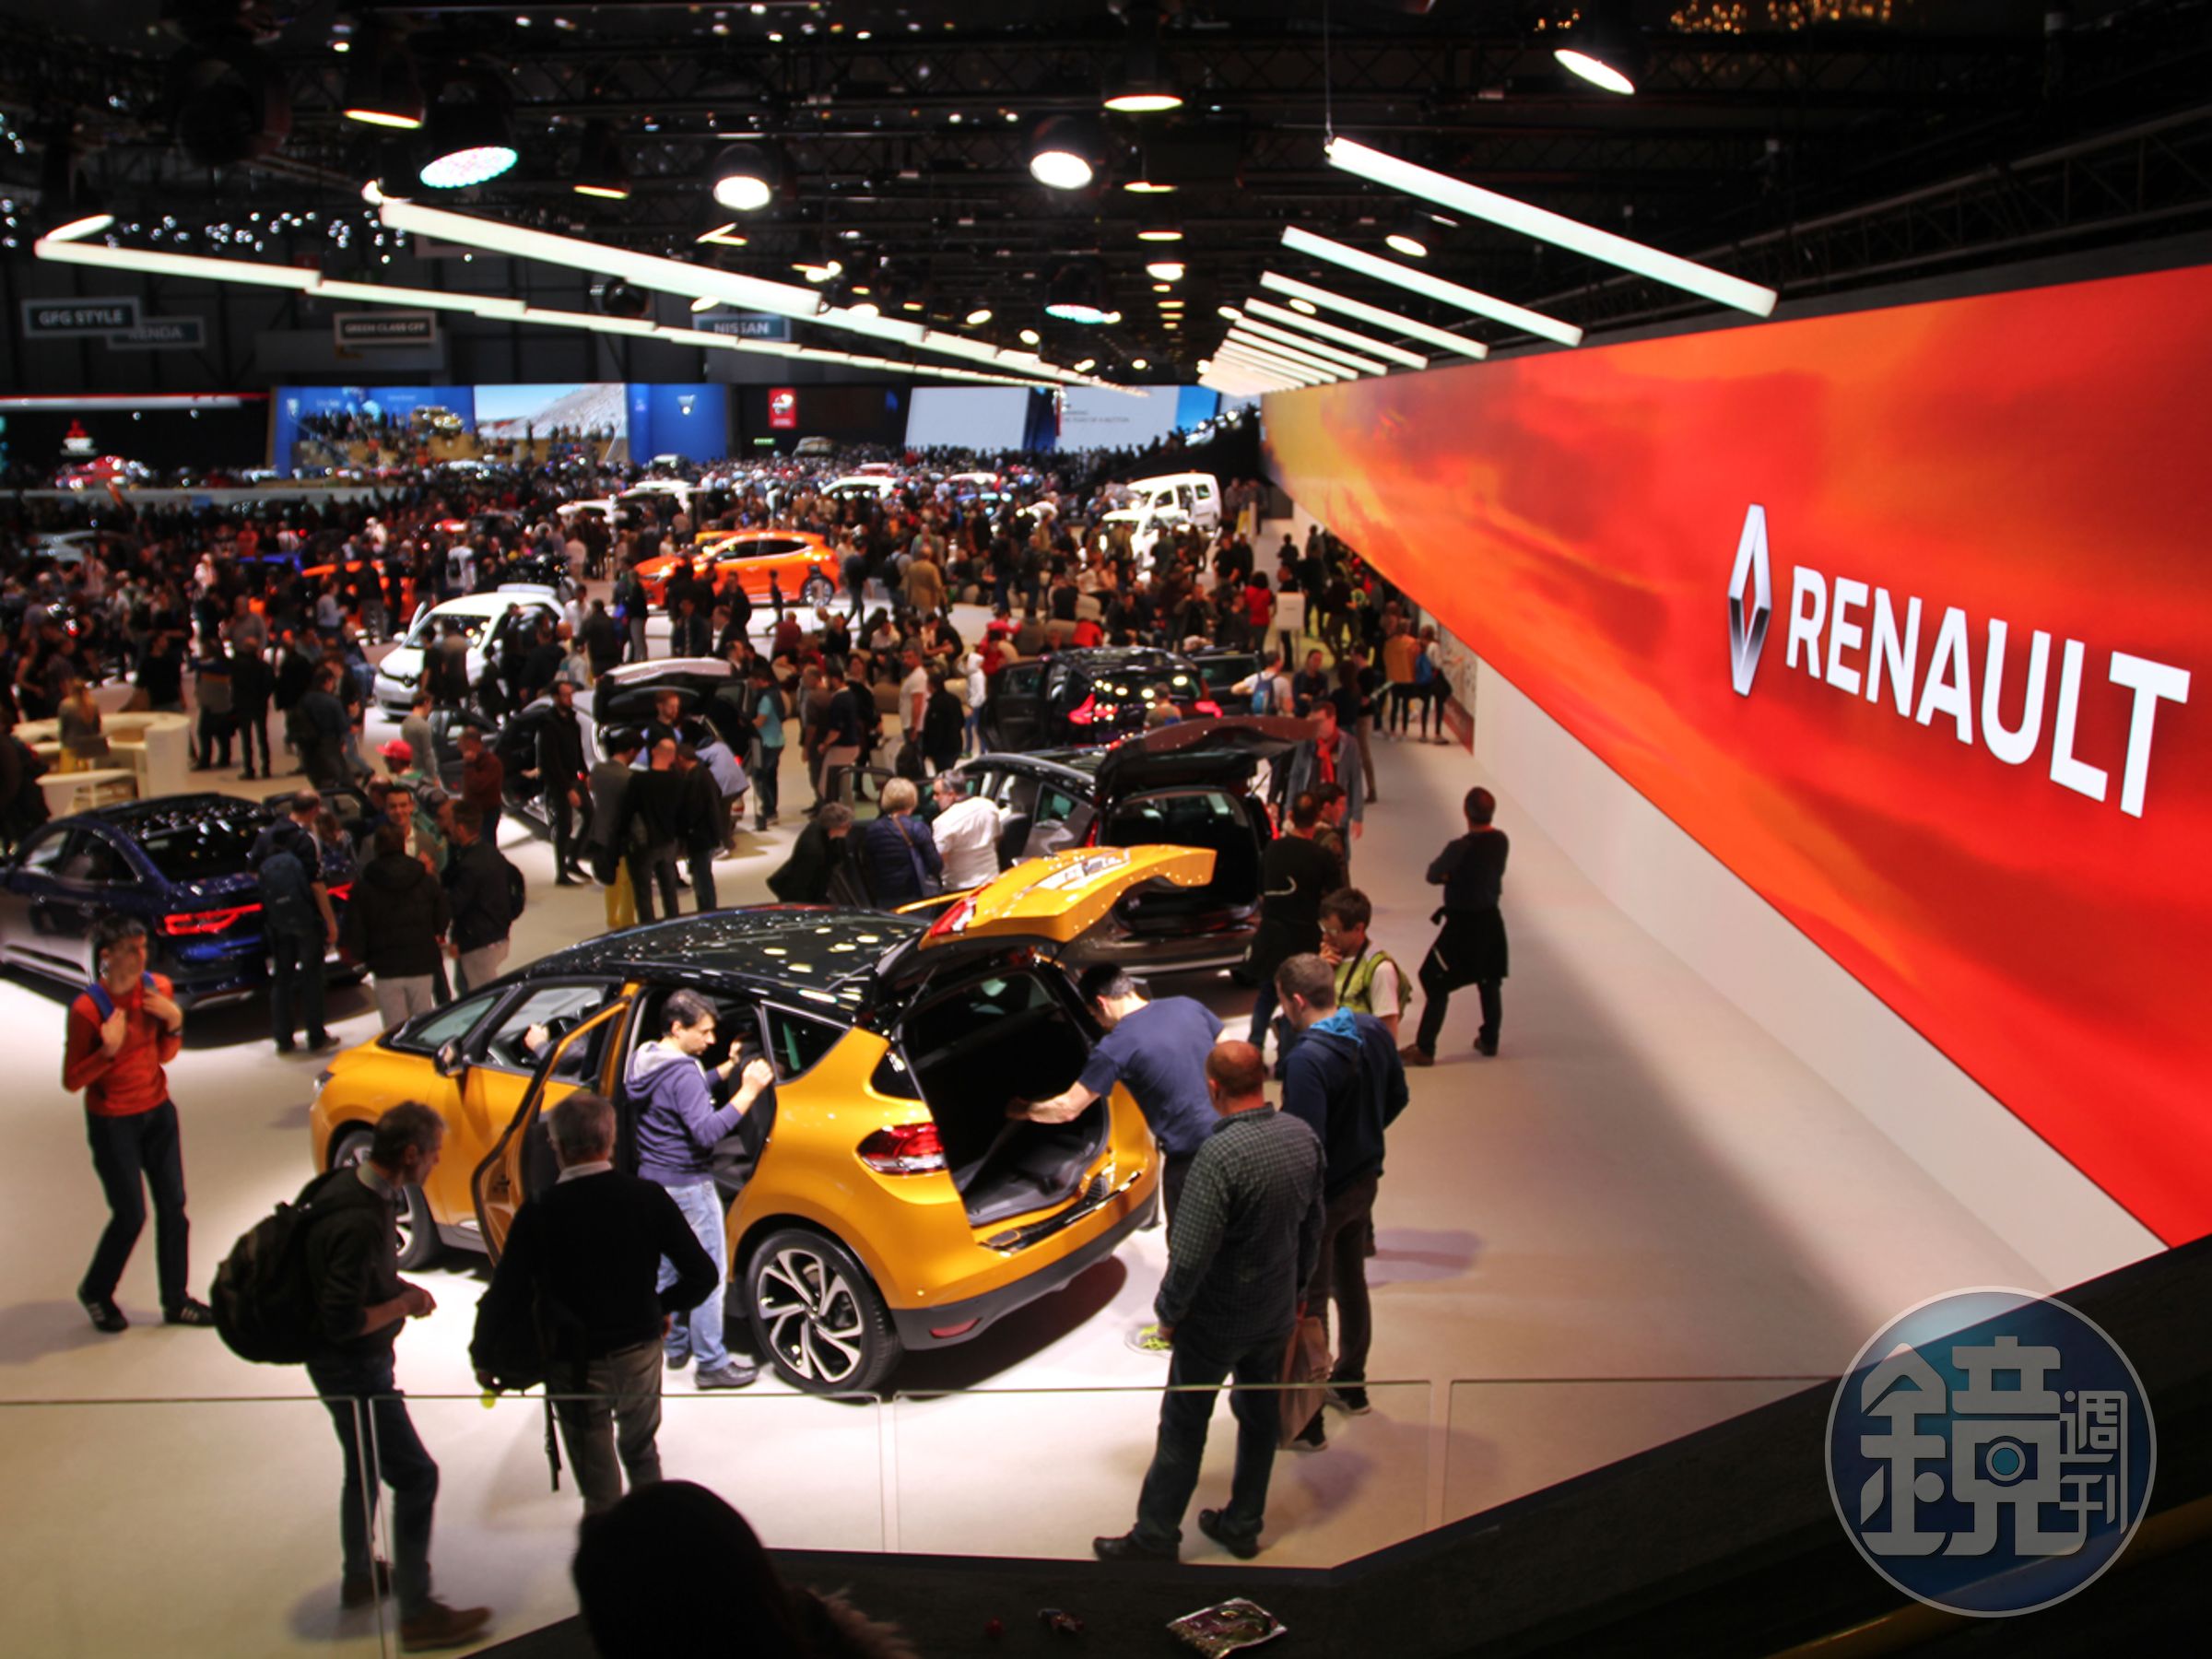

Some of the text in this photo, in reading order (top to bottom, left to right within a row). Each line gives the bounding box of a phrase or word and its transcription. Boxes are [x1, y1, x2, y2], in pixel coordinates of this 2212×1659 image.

[39, 309, 124, 326] GFG STYLE
[714, 322, 771, 335] NISSAN
[1786, 565, 2191, 818] RENAULT
